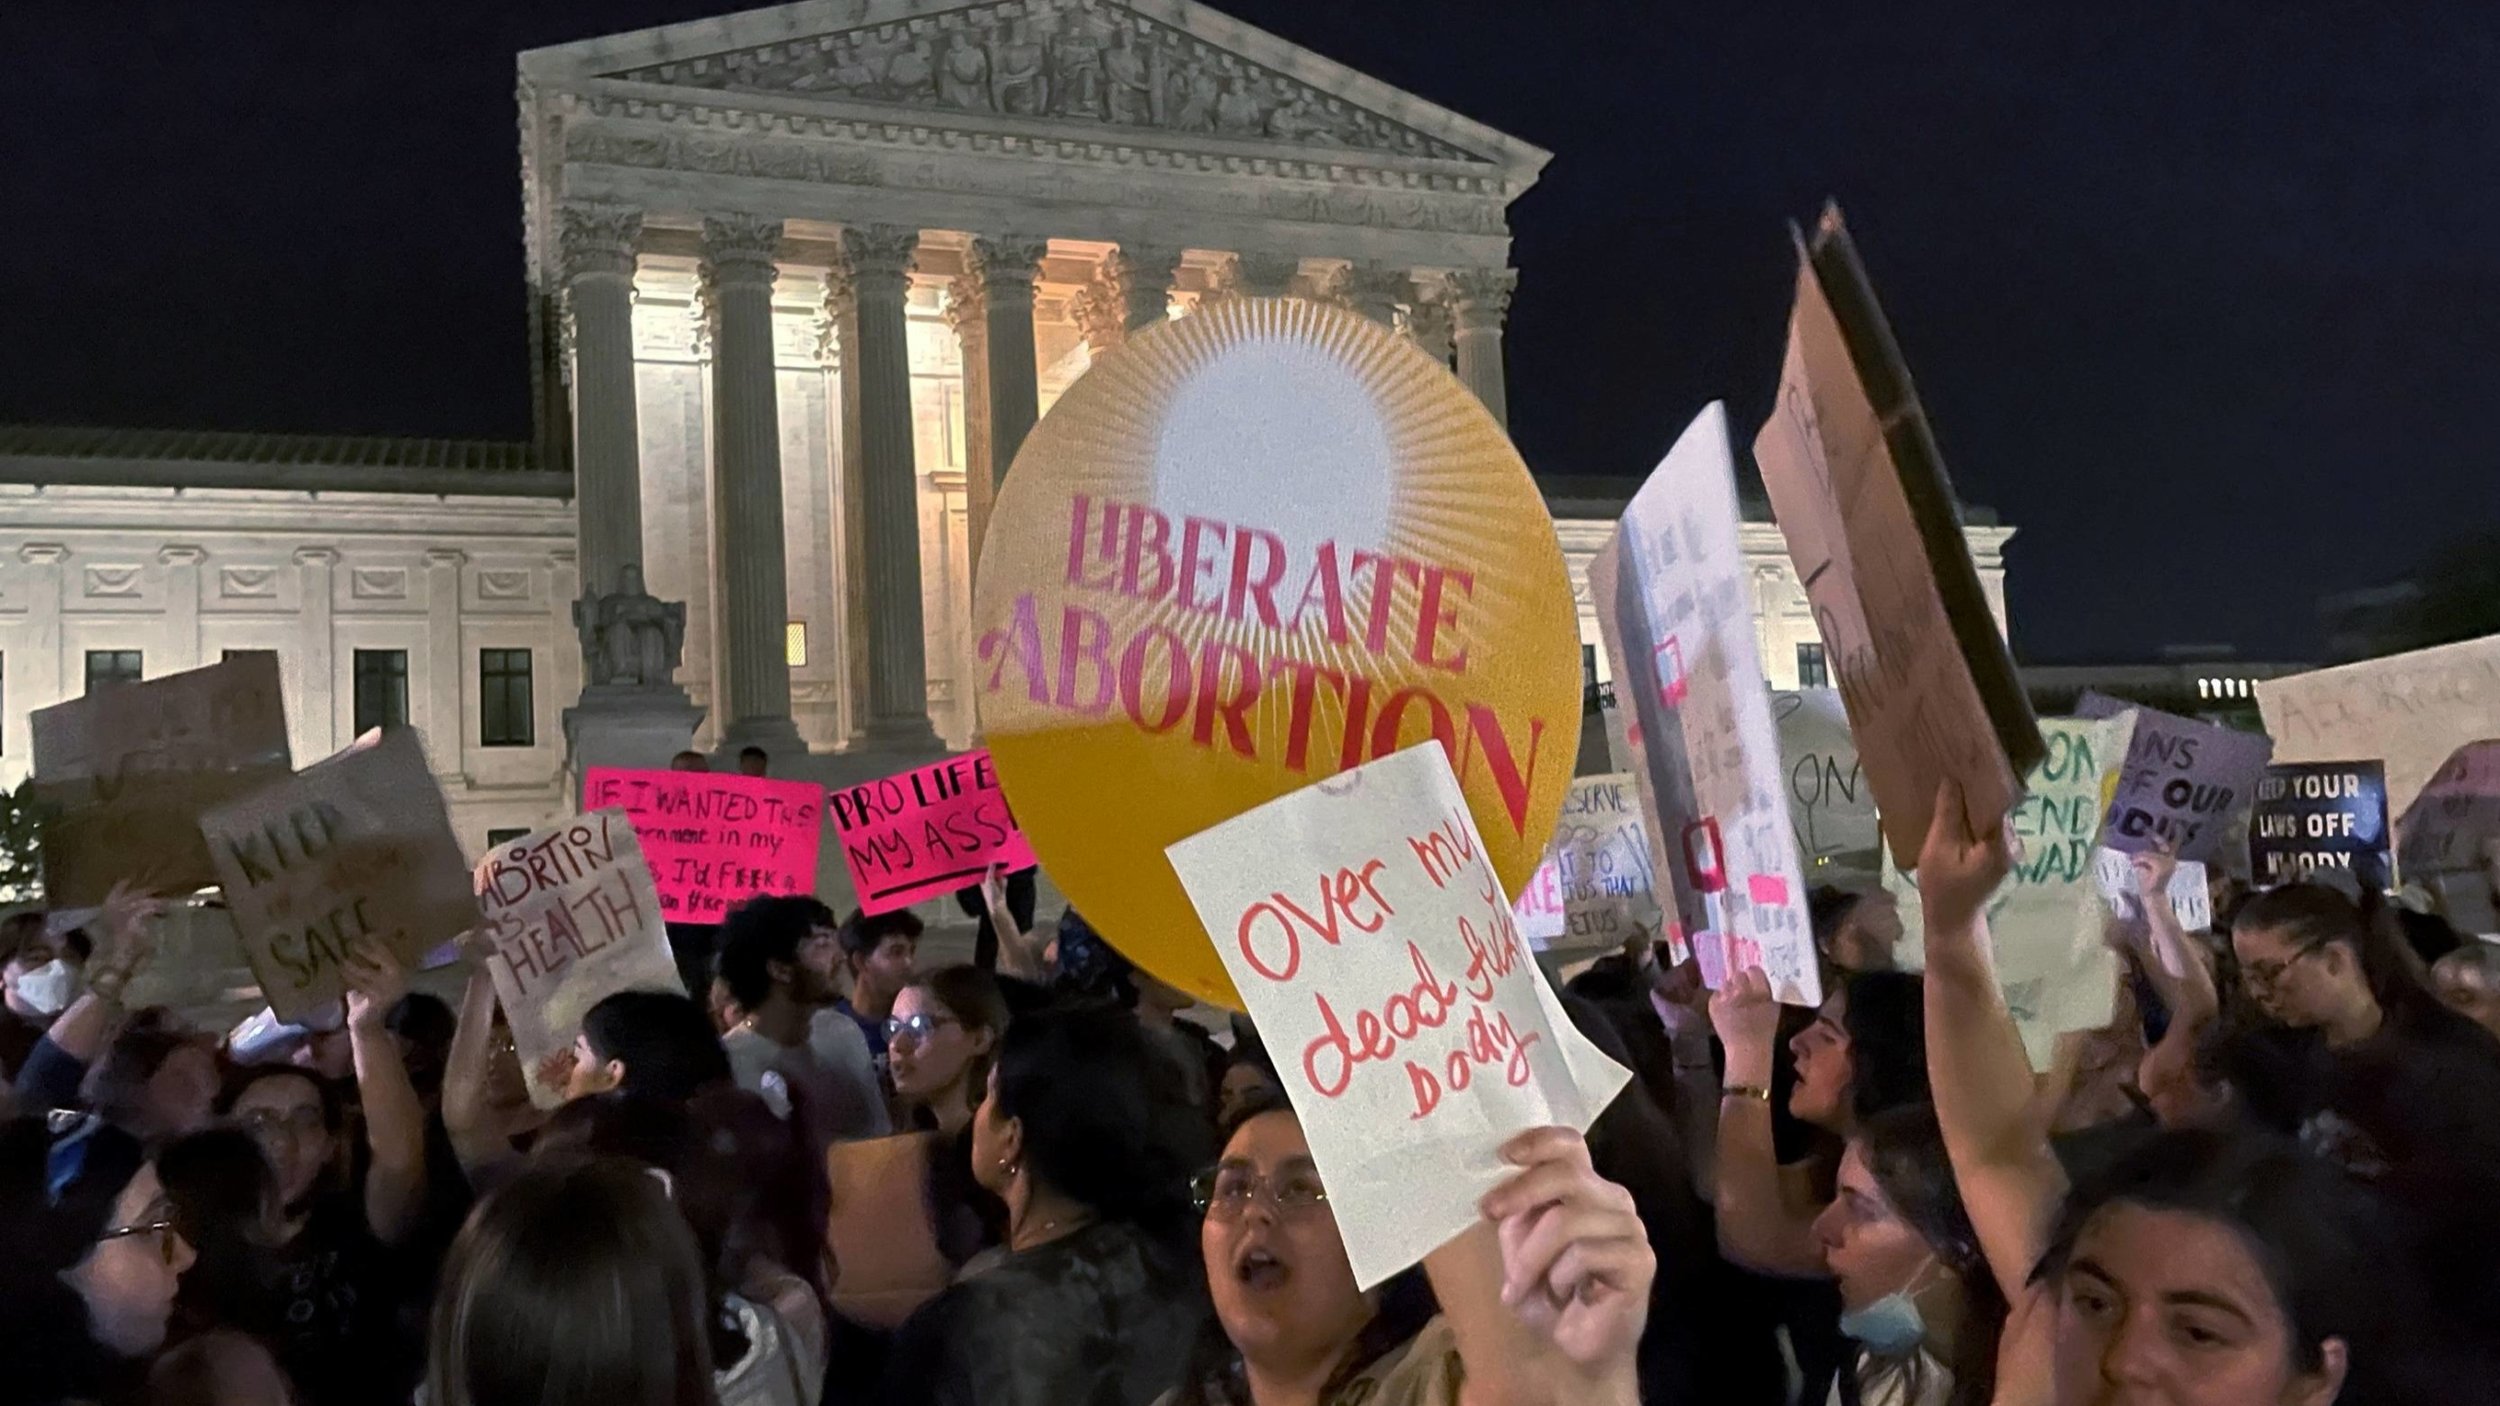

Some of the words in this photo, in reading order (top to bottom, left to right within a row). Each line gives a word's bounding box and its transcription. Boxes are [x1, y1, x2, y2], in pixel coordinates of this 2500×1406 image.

[1066, 493, 1474, 673] LIBERATE
[978, 592, 1545, 842] ABORTION
[594, 778, 622, 806] IF
[626, 780, 651, 814] I
[656, 785, 758, 823] WANTED
[763, 797, 816, 827] THE
[831, 779, 904, 832] PRO
[910, 754, 999, 807] LIFE
[2162, 778, 2235, 814] OUR
[2259, 813, 2297, 838] LAWS
[2306, 812, 2356, 838] OFF
[2293, 772, 2360, 800] YOUR
[481, 815, 615, 912] ABORTION
[717, 827, 741, 846] in
[750, 829, 785, 857] my
[848, 827, 914, 886] MY
[502, 867, 644, 996] HEALTH
[1236, 857, 1396, 983] Over
[1407, 807, 1496, 905] my
[1303, 938, 1459, 1100] dead
